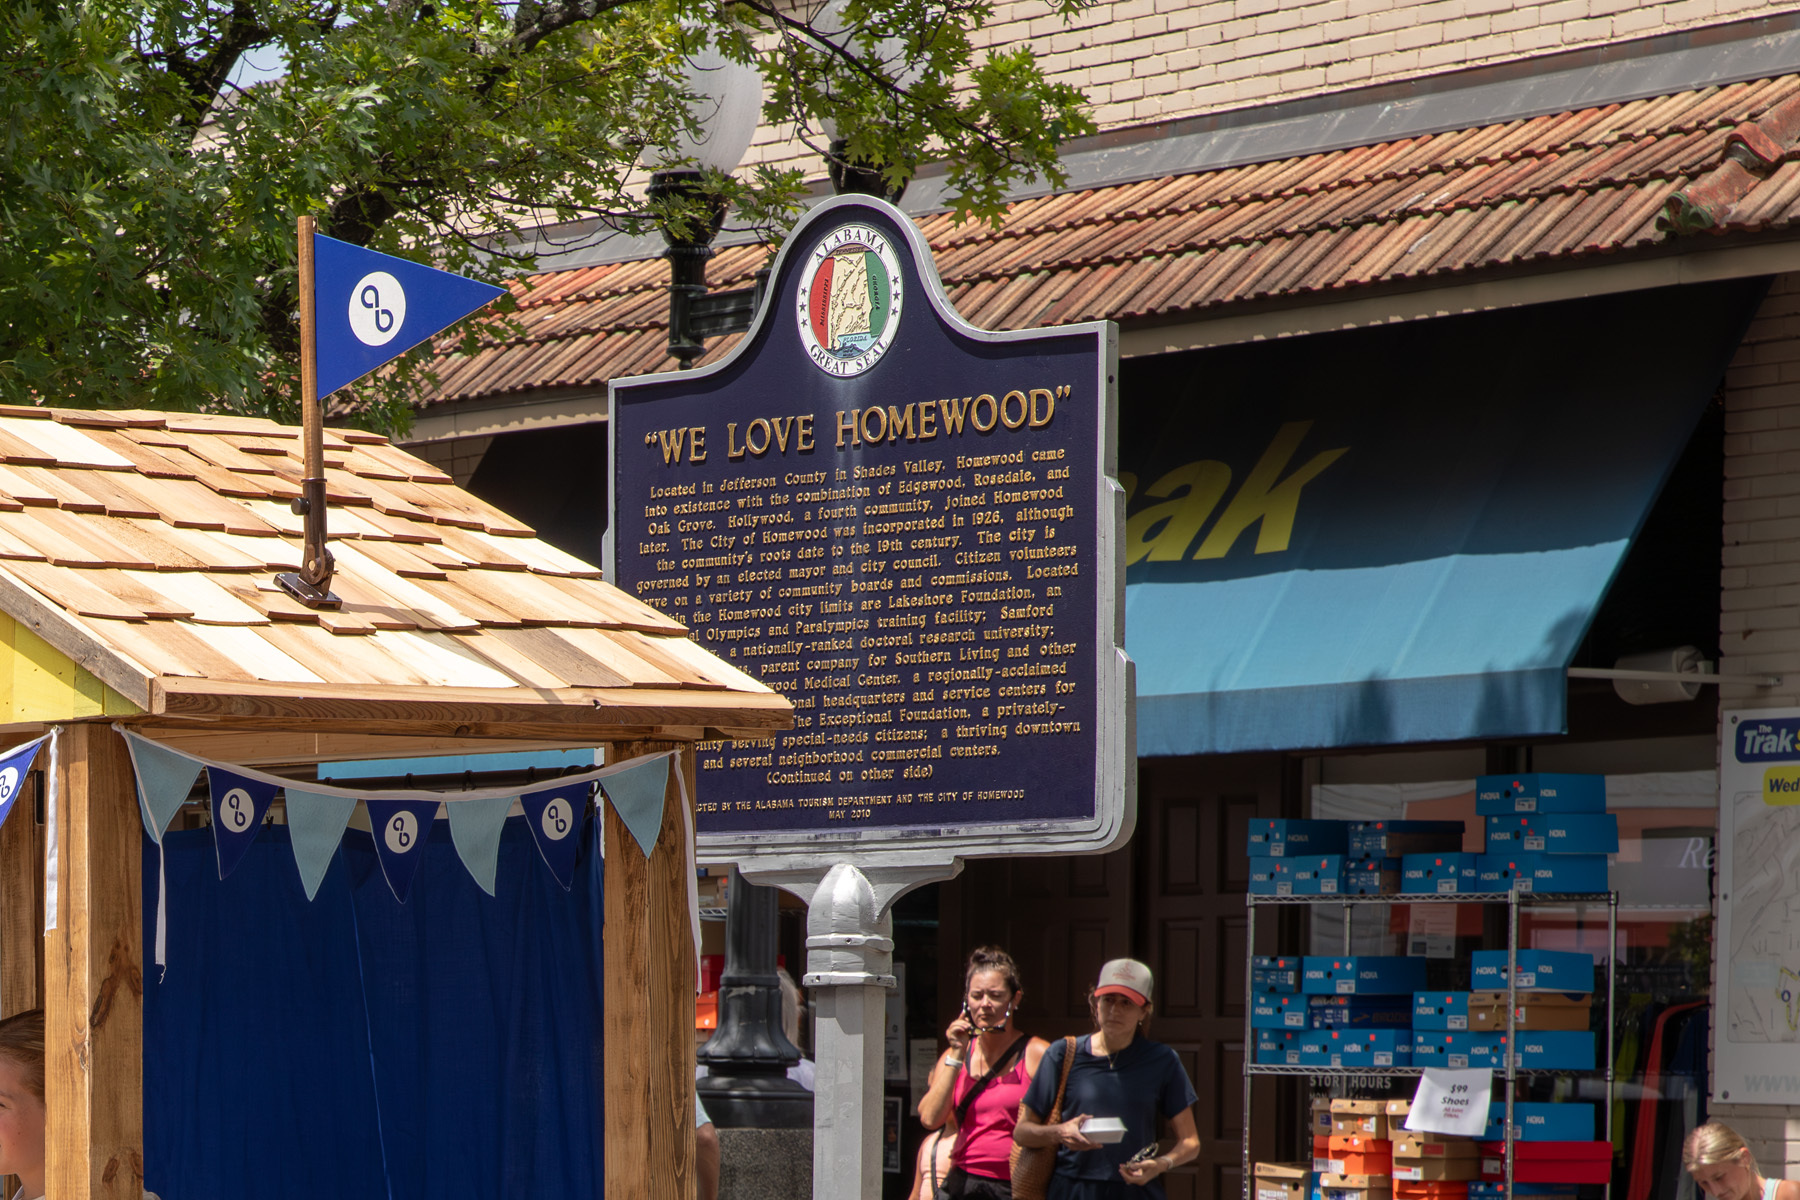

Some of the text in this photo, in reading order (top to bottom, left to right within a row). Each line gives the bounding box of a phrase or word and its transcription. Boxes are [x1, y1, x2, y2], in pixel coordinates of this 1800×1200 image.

[815, 229, 886, 264] ALABAMA
[810, 340, 888, 375] GREAT SEAL
[727, 414, 814, 457] LOVE
[650, 448, 1064, 498] Located Jefferson County Shades Valley, Homewood came
[644, 469, 1035, 517] into existence with combination Edgewood, Rosedale,
[648, 485, 1063, 535] Oak Grove. Hollywood, fourth community, joined Homewood
[639, 504, 1073, 554] later. City Homewood incorporated 1926, although
[681, 527, 1035, 568] community's roots date 19th century. city
[636, 545, 1076, 594] governed elected mayor city council. Citizen volunteers
[638, 562, 1078, 607] erve variety community boards commissions. Located
[718, 585, 1034, 621] Homewood city limits Lakeshore Foundation,
[705, 626, 760, 641] Olympics
[795, 617, 869, 634] Paralympics
[876, 613, 926, 628] training
[934, 609, 986, 624] facility;
[1000, 603, 1053, 619] Samford
[743, 623, 1053, 656] nationally-ranked doctoral research university;
[760, 660, 799, 676] parent
[806, 658, 859, 671] company
[895, 650, 951, 664] Southern
[959, 646, 999, 661] Living
[1039, 641, 1076, 655] other
[804, 674, 850, 689] Medical
[857, 674, 900, 685] Center,
[928, 661, 1066, 684] regionally-acclaimed
[819, 700, 1065, 726] Exceptional Foundation, privately-
[823, 692, 904, 708] headquarters
[942, 685, 990, 699] service
[998, 683, 1046, 696] centers
[782, 731, 868, 748] special-needs
[874, 728, 927, 741] citizens;
[955, 723, 1006, 738] thriving
[1014, 720, 1080, 734] downtown
[1744, 728, 1794, 754] Trak
[1759, 725, 1772, 733] The
[730, 744, 1000, 767] several neighborhood commercial centers.
[766, 764, 932, 783] (Continued other side)
[1309, 1075, 1392, 1089] STOR HOURS
[1450, 1084, 1468, 1094] $99
[1441, 1096, 1469, 1105] Shoes
